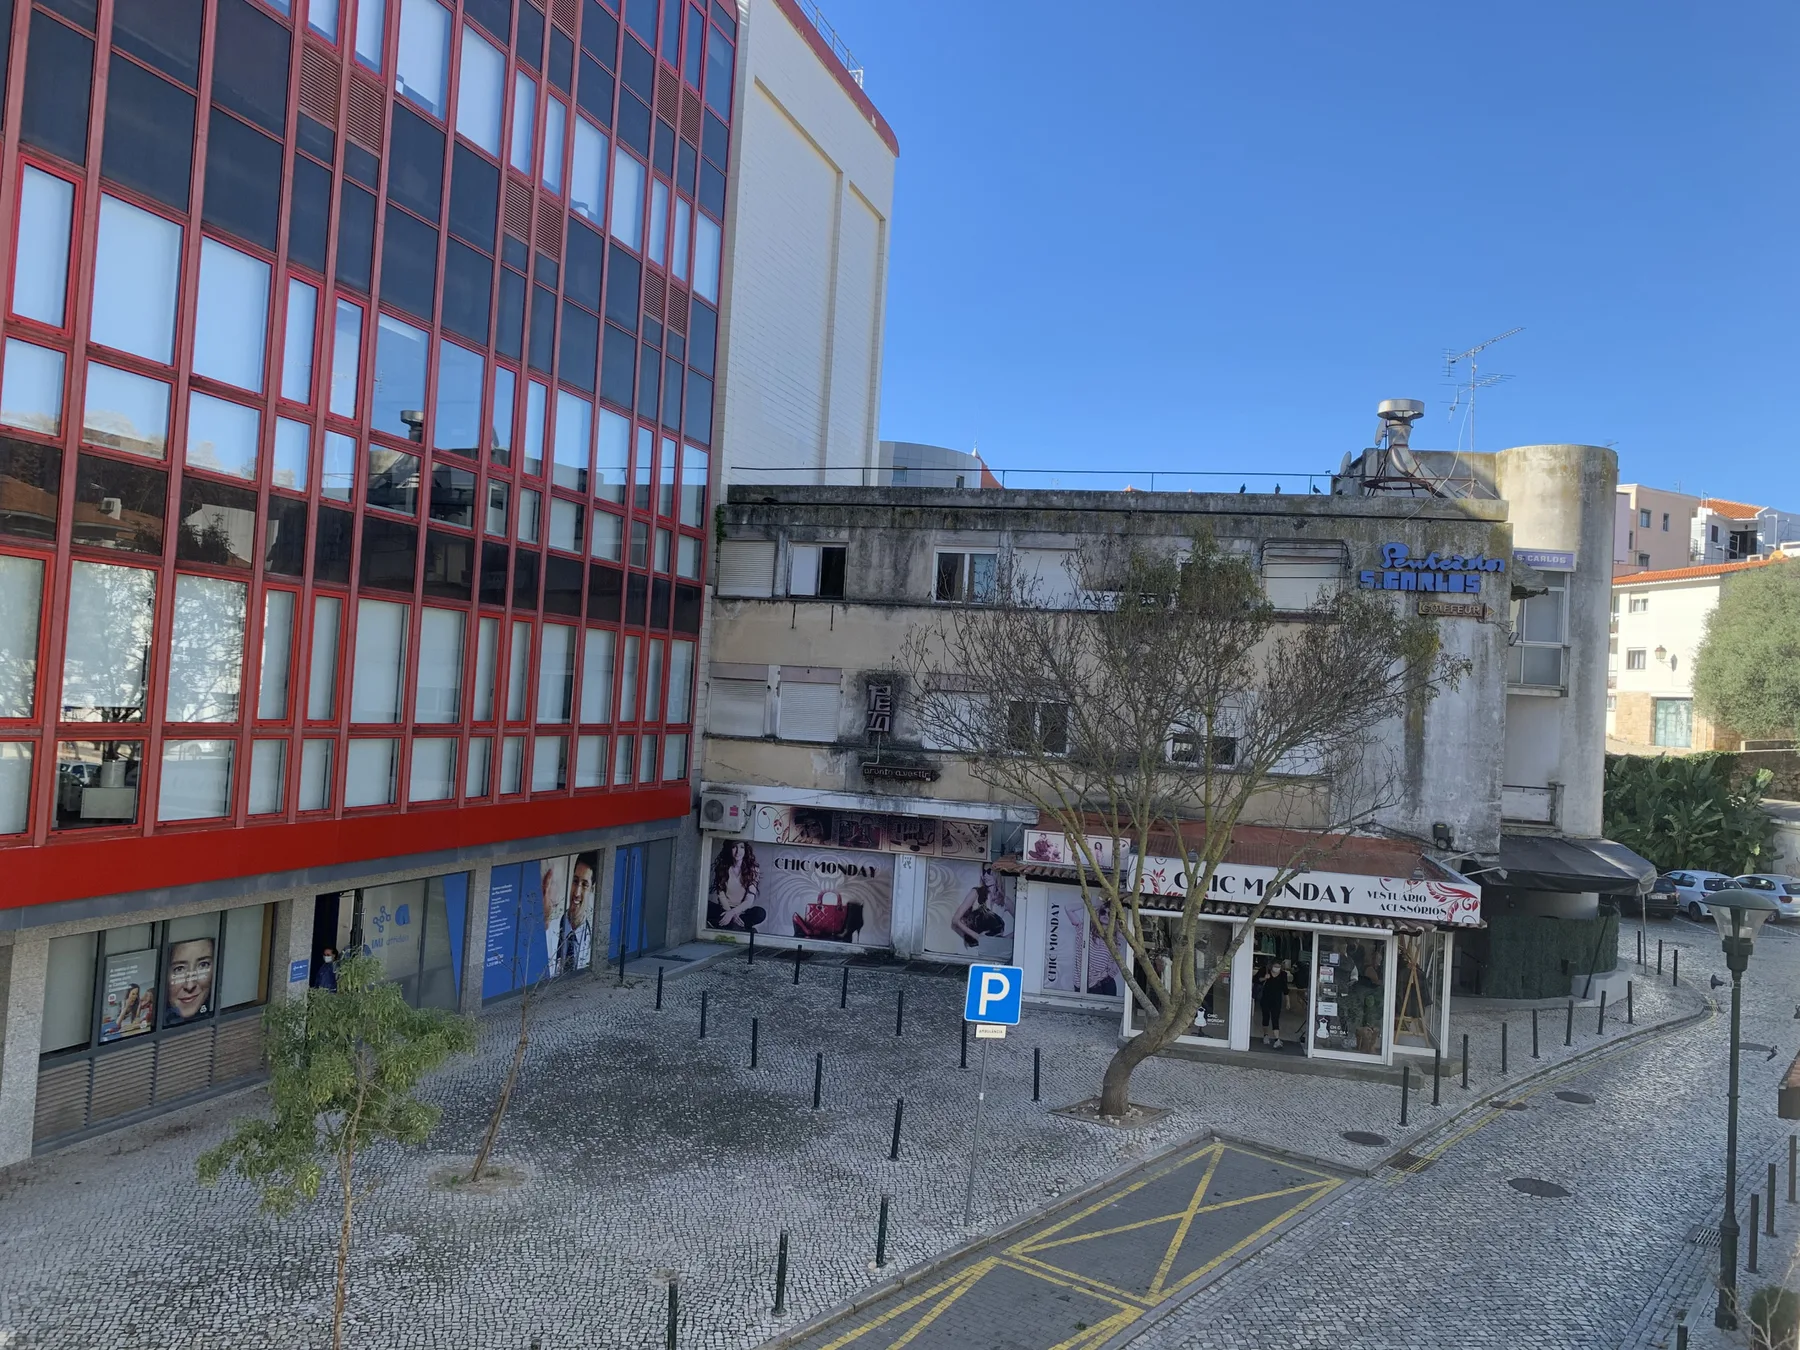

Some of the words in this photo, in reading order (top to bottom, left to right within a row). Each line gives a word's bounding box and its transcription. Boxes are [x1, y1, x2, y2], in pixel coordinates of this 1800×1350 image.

[1527, 555, 1567, 564] CARLOS
[774, 857, 810, 872] CHIC
[814, 860, 877, 878] MONDAY
[1367, 890, 1427, 903] VESTUÁRIO
[1379, 902, 1447, 916] ACESSÓRIOS
[1049, 902, 1060, 951] MONDAY
[1047, 954, 1058, 982] CHIC
[978, 972, 1010, 1016] P
